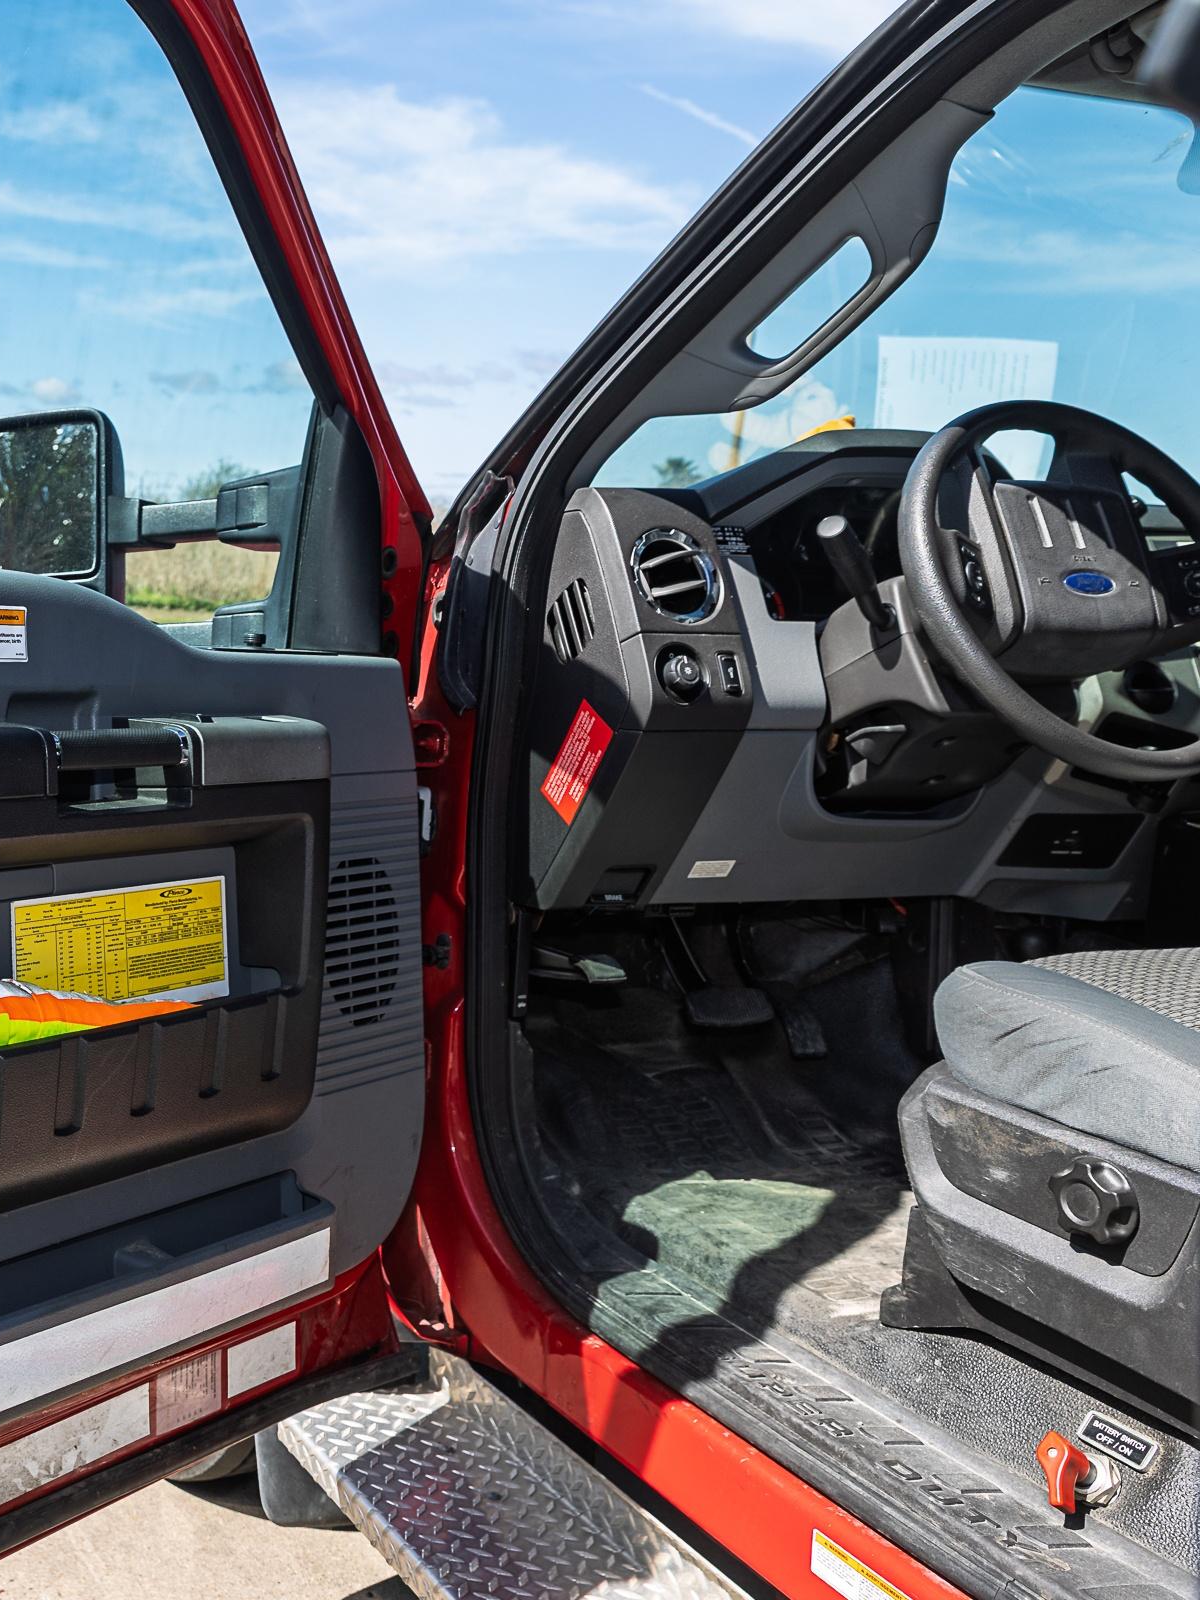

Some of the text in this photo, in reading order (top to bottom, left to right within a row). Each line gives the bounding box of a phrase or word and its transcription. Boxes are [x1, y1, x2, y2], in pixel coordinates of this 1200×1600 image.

[1093, 1420, 1146, 1451] BATTERY SWITCH
[1096, 1433, 1114, 1445] OFF
[1119, 1445, 1133, 1456] ON
[875, 1459, 1043, 1554] DUTY
